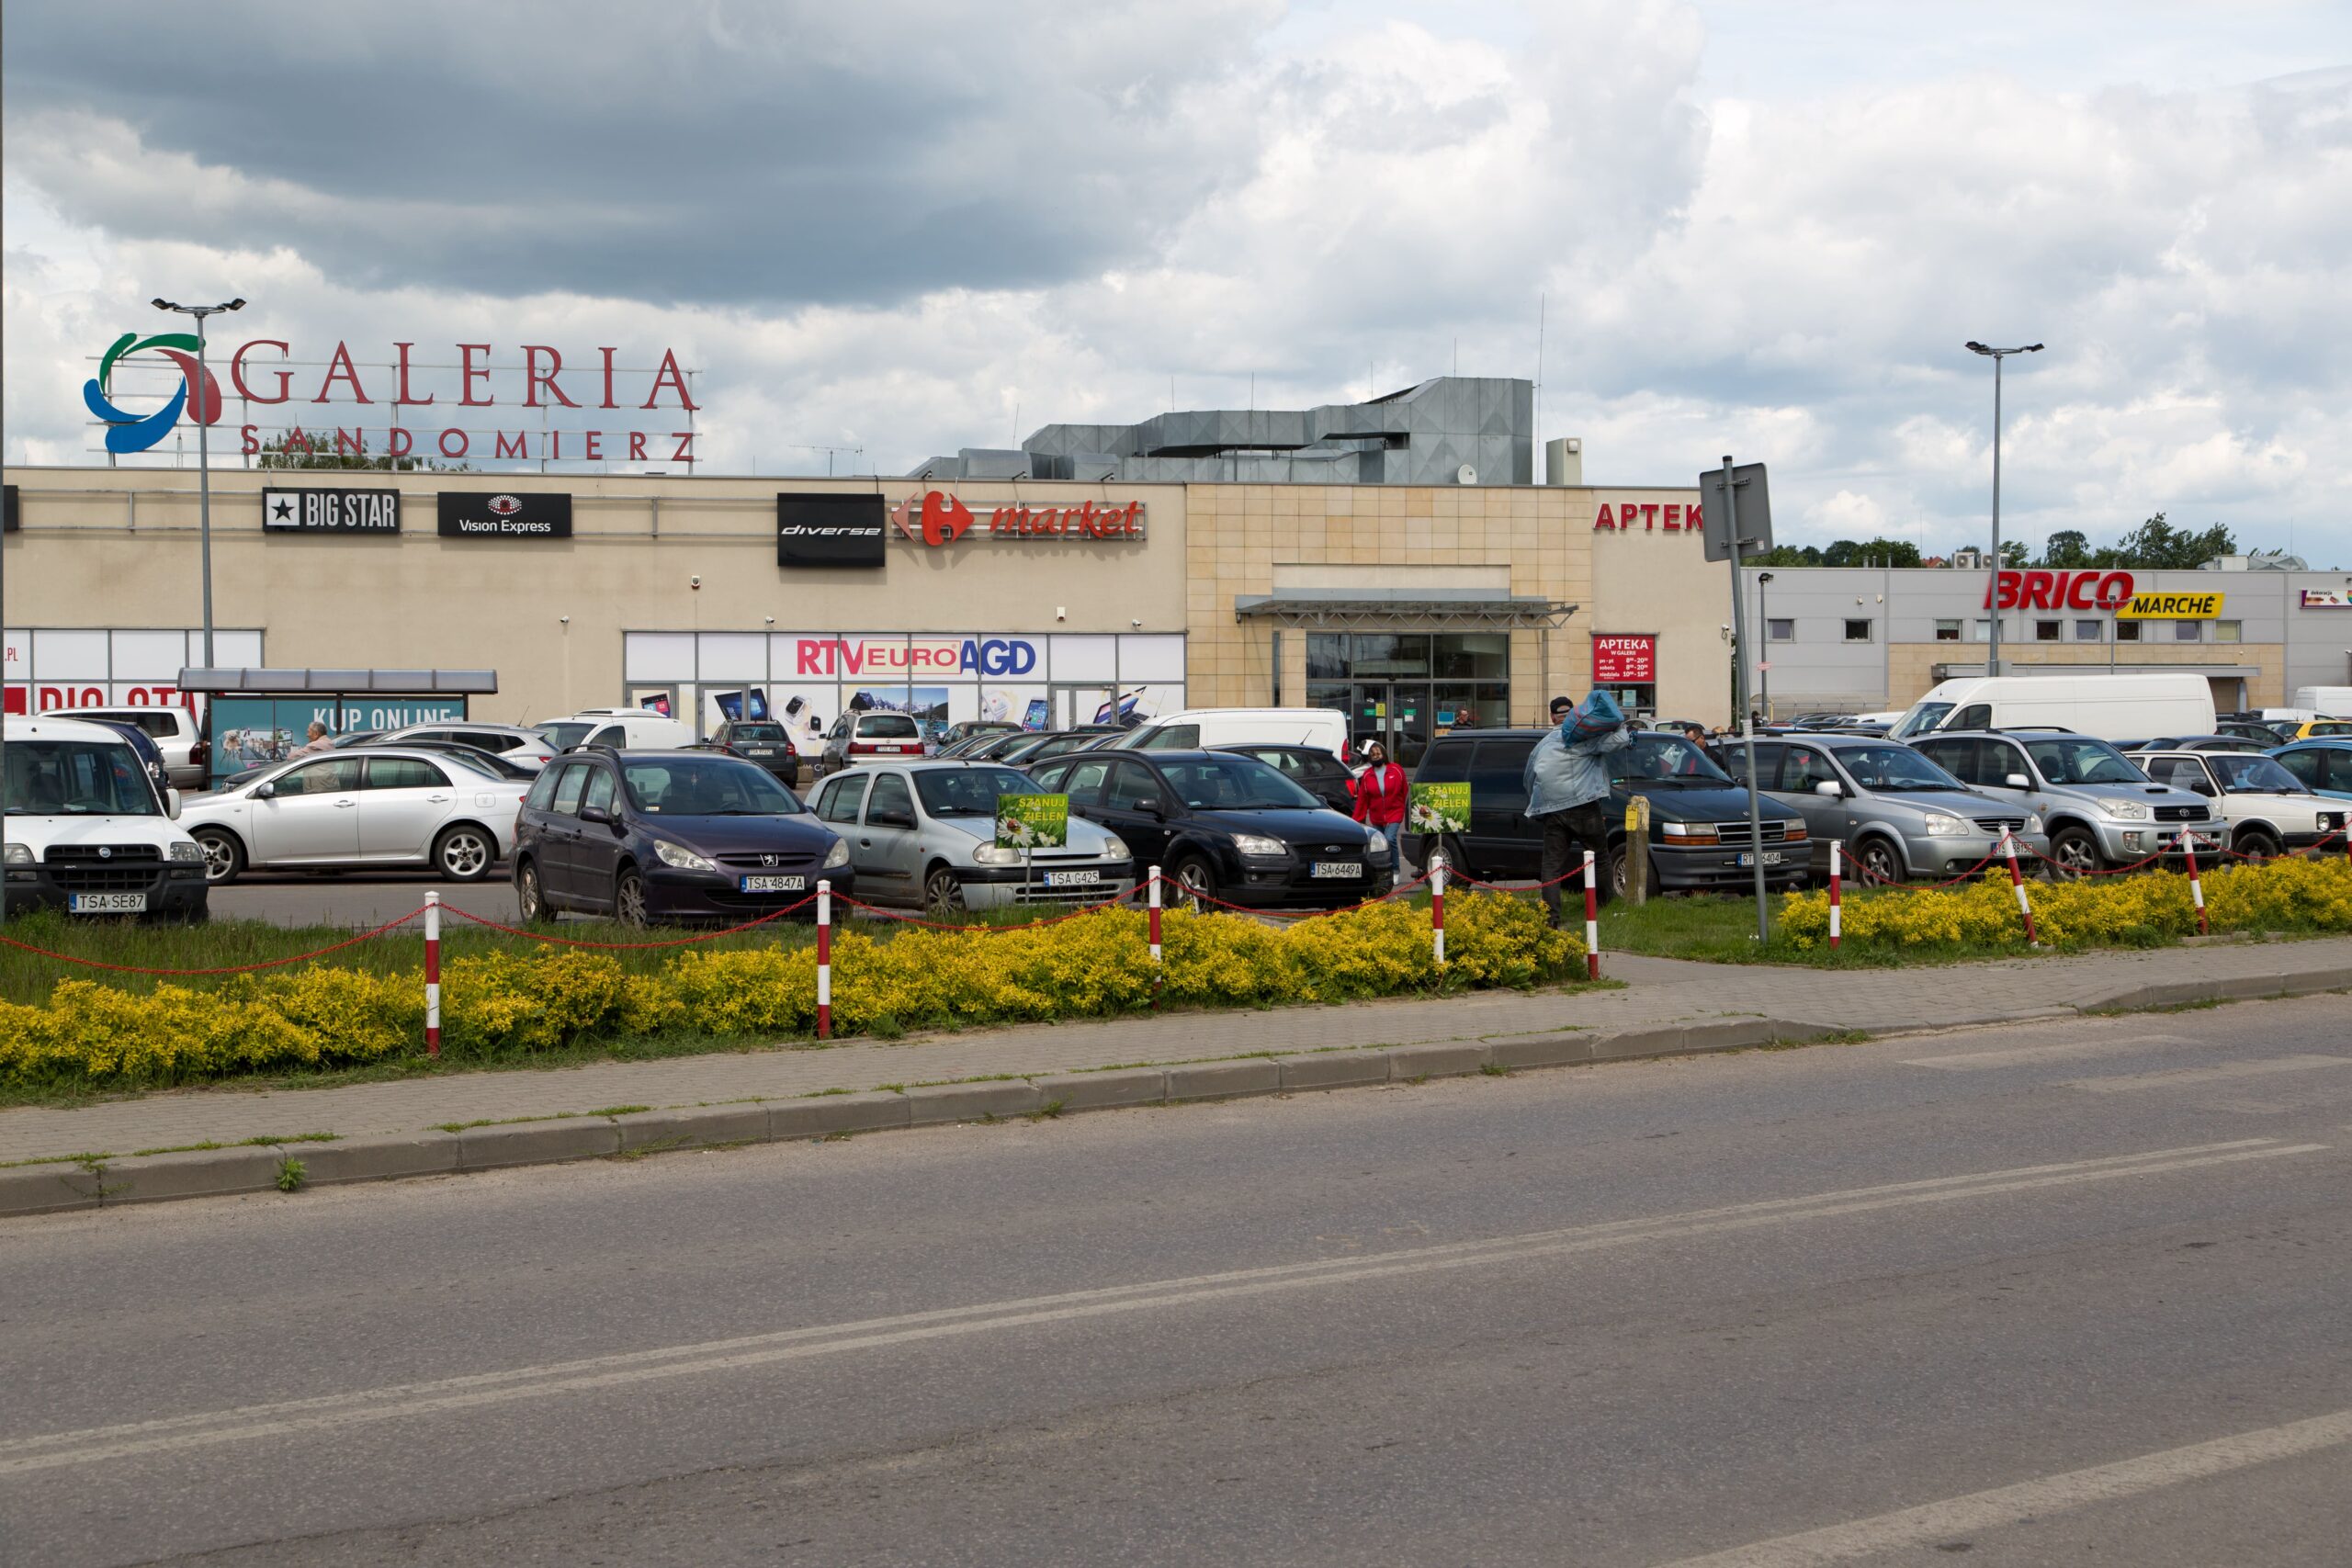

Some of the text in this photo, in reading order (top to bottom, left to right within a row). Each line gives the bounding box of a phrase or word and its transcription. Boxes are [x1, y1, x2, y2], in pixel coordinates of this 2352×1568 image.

[232, 339, 701, 411] GALERIA
[241, 424, 695, 462] SANDOMIERZ
[306, 493, 395, 527] BIG STAR
[1594, 502, 1703, 530] APTEK
[459, 519, 551, 534] Vision Express
[989, 500, 1144, 538] market
[780, 525, 882, 536] diverse
[1983, 571, 2134, 610] BRICO
[2132, 595, 2216, 614] MARCHÉ
[1599, 639, 1649, 649] APTEKA
[797, 639, 1036, 675] RTV EURO AGD
[313, 708, 362, 731] KUP
[1429, 785, 1469, 795] SZANUJ
[1018, 797, 1066, 807] SZANUJ
[1316, 863, 1361, 874] TSA 6449A
[748, 877, 804, 889] TSA 4847A
[1051, 872, 1099, 885] TSA G425
[79, 895, 144, 908] TSA SE87
